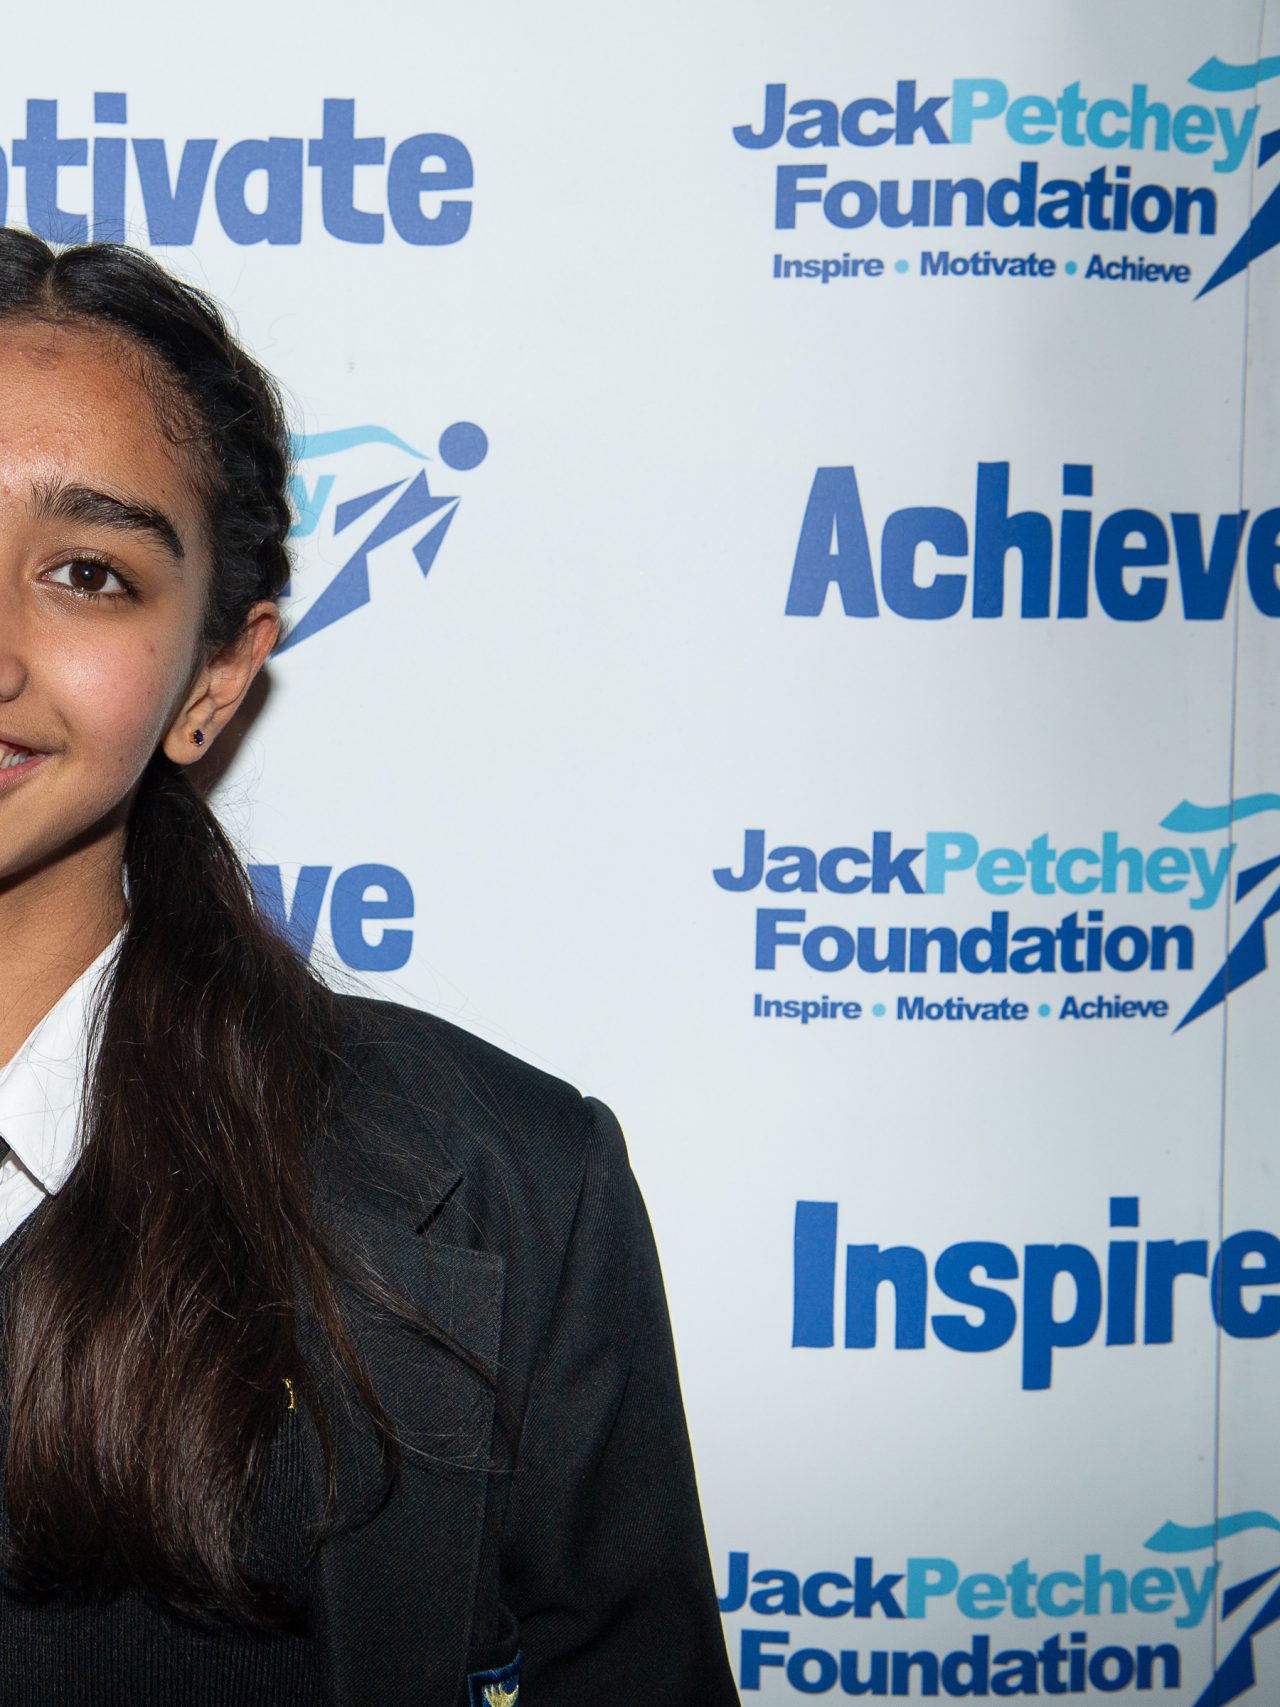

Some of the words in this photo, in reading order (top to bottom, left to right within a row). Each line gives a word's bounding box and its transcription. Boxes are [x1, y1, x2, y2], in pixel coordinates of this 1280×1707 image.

[774, 160, 1218, 236] Foundation
[772, 252, 884, 284] Inspire
[920, 251, 1057, 278] Motivate
[1084, 254, 1191, 283] Achieve
[754, 907, 1194, 974] Foundation
[753, 993, 862, 1024] Inspire
[896, 995, 1029, 1021] Motivate
[1058, 995, 1169, 1020] Achieve
[792, 1196, 1280, 1391] Inspire
[739, 1628, 1180, 1697] Foundation
